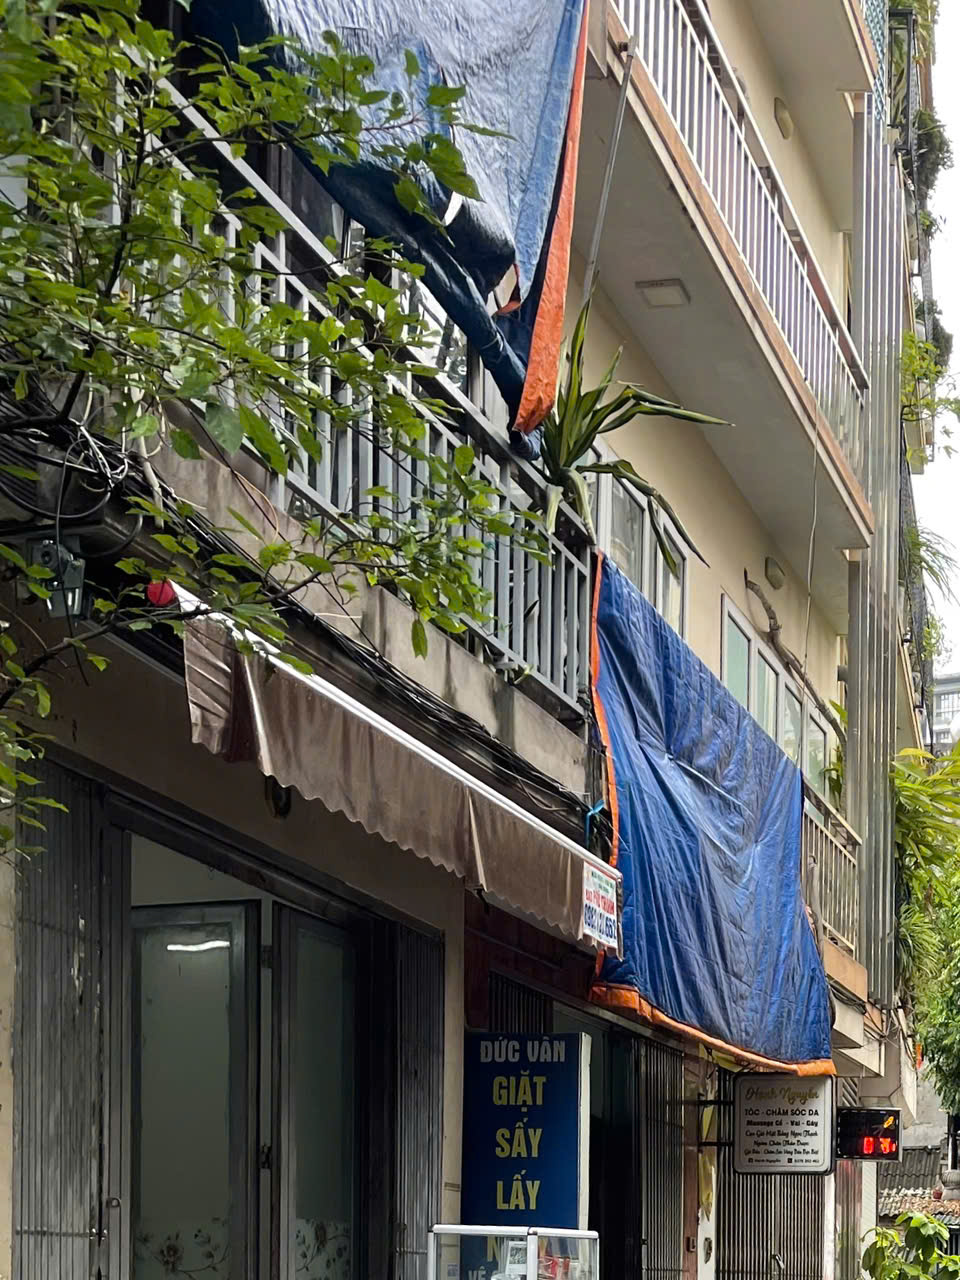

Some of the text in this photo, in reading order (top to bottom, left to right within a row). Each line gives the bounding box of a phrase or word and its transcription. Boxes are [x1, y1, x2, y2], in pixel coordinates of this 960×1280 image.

[480, 1035, 565, 1063] ĐỨC VÂN
[492, 1069, 546, 1112] GIẶT
[790, 1107, 807, 1116] SÓC
[495, 1117, 543, 1158] SẤY
[496, 1169, 541, 1210] LẤY
